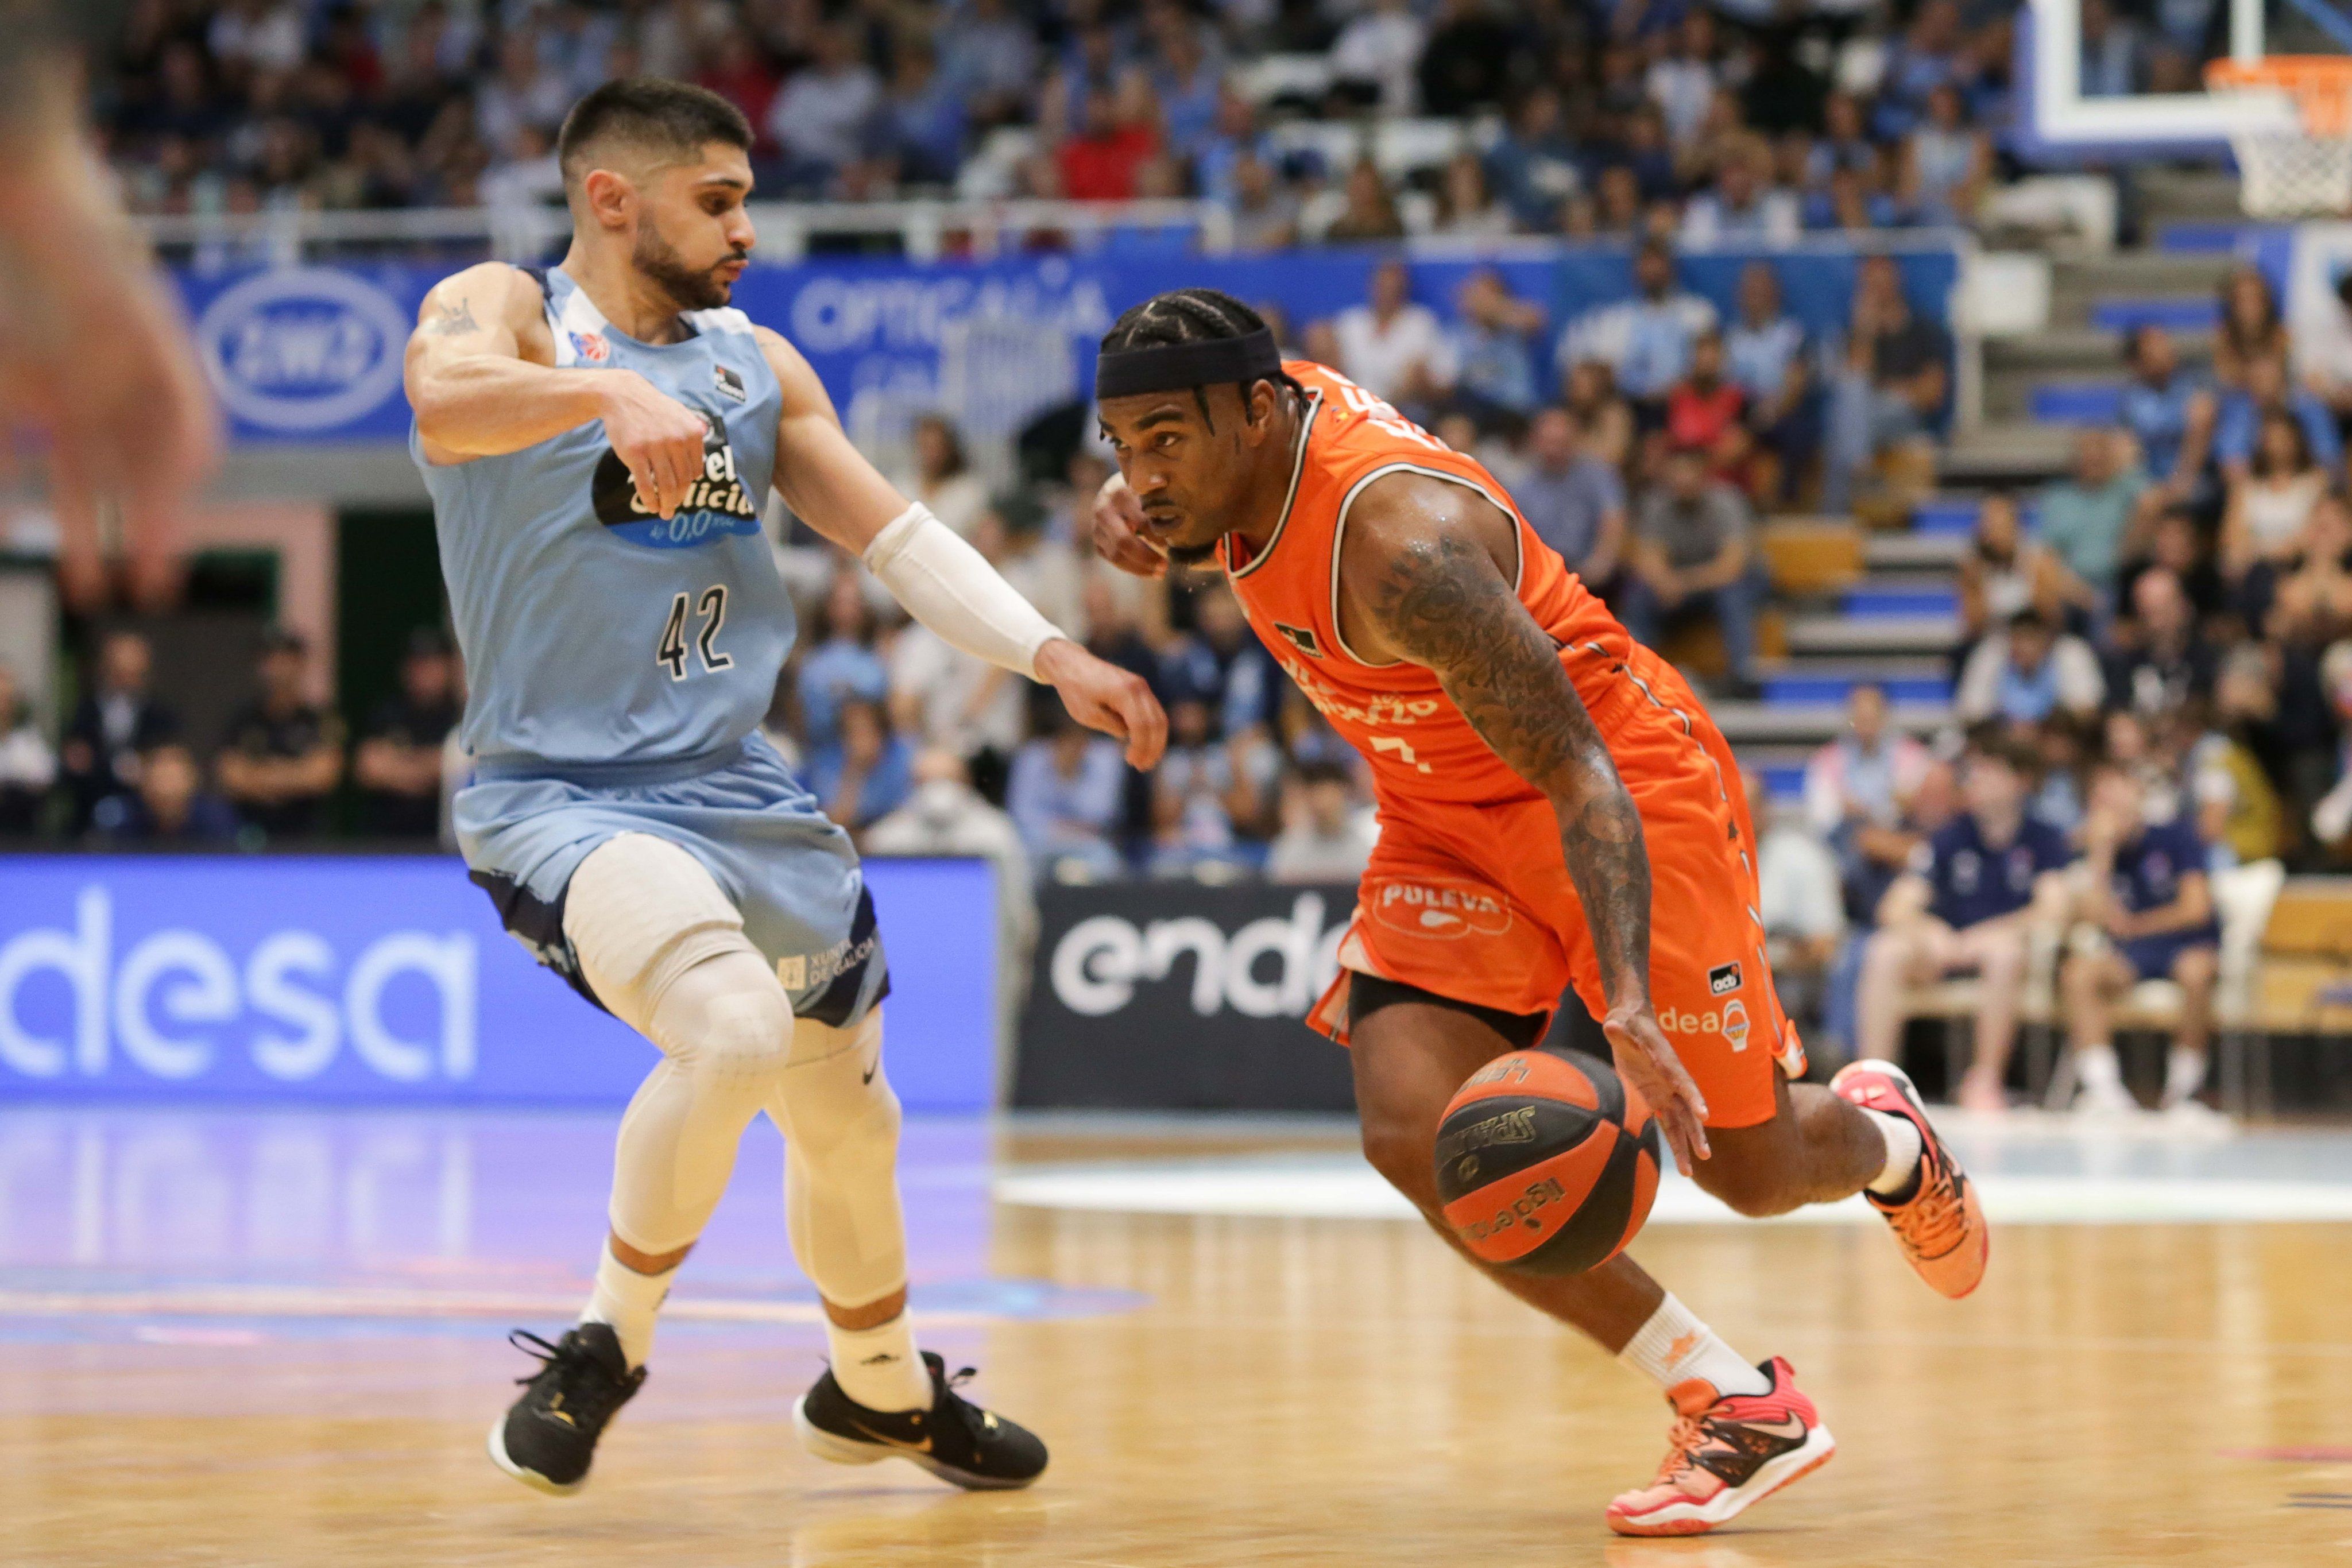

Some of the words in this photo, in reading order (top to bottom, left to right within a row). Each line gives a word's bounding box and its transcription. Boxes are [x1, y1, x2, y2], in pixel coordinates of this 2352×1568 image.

[656, 584, 736, 683] 42
[1369, 736, 1433, 775] 7
[1383, 884, 1501, 914] PULEVA
[1654, 1006, 1720, 1035] dea
